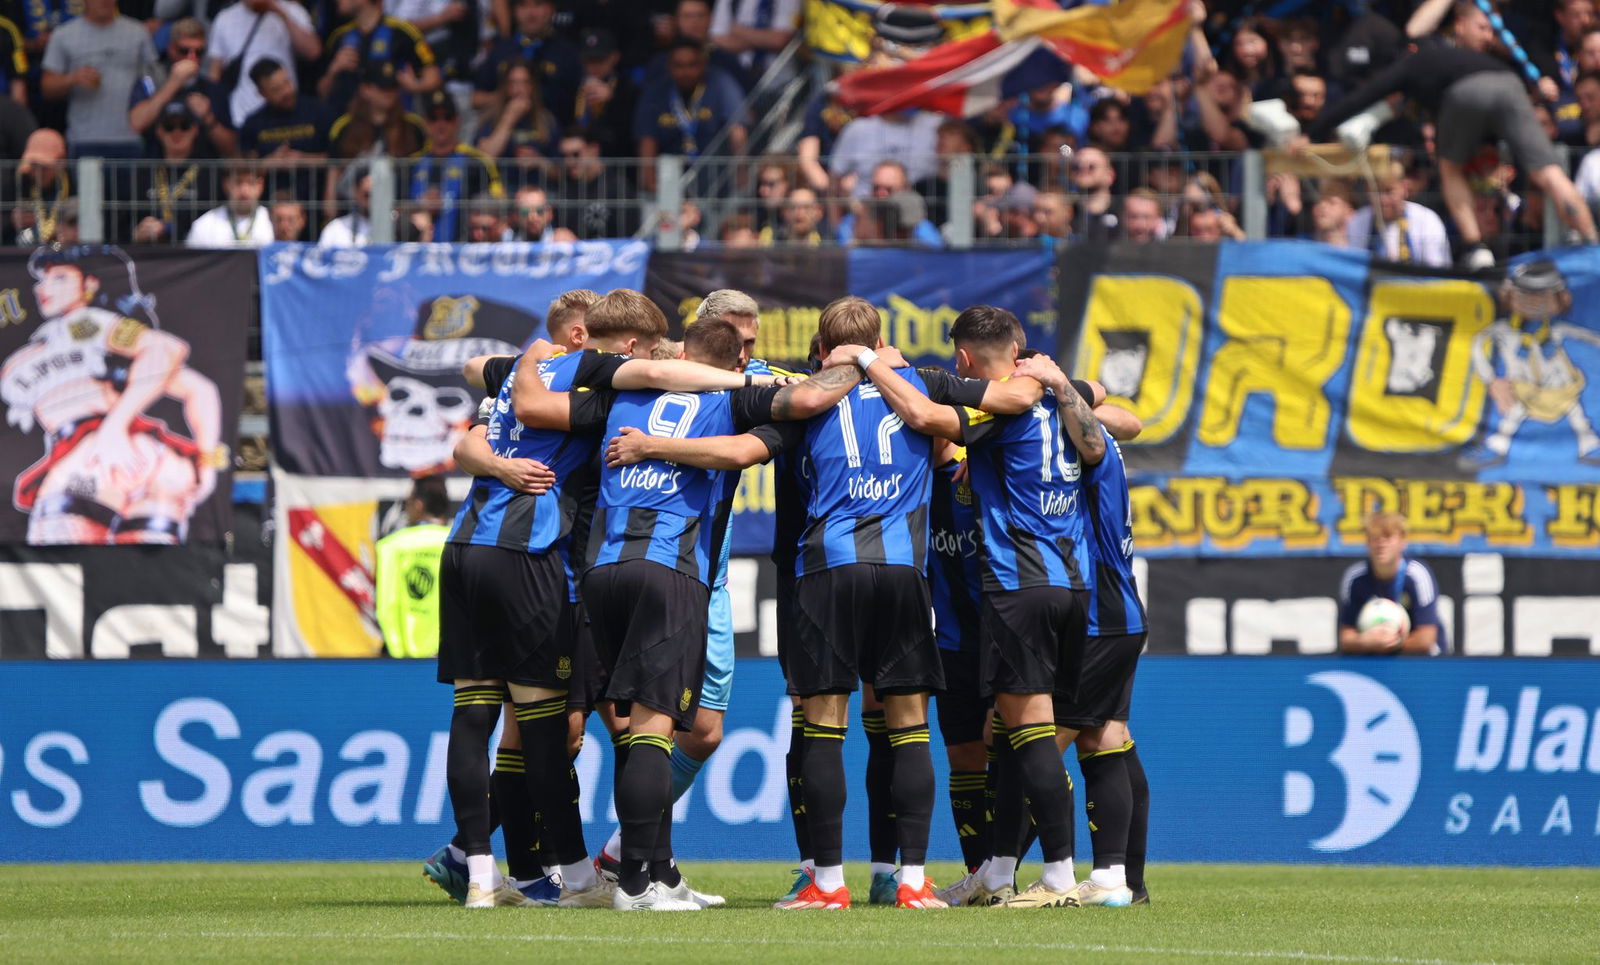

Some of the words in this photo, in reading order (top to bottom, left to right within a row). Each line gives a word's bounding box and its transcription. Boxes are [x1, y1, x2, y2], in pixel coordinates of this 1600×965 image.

[836, 382, 908, 468] 17
[620, 465, 682, 494] Victor's
[848, 473, 903, 501] Victor's
[1039, 490, 1079, 516] Victor's
[1130, 476, 1329, 547] NUR
[1335, 476, 1534, 548] DER
[928, 528, 978, 558] ictor's
[1454, 685, 1600, 773] bla
[0, 730, 90, 828] s
[1444, 792, 1600, 836] SAA
